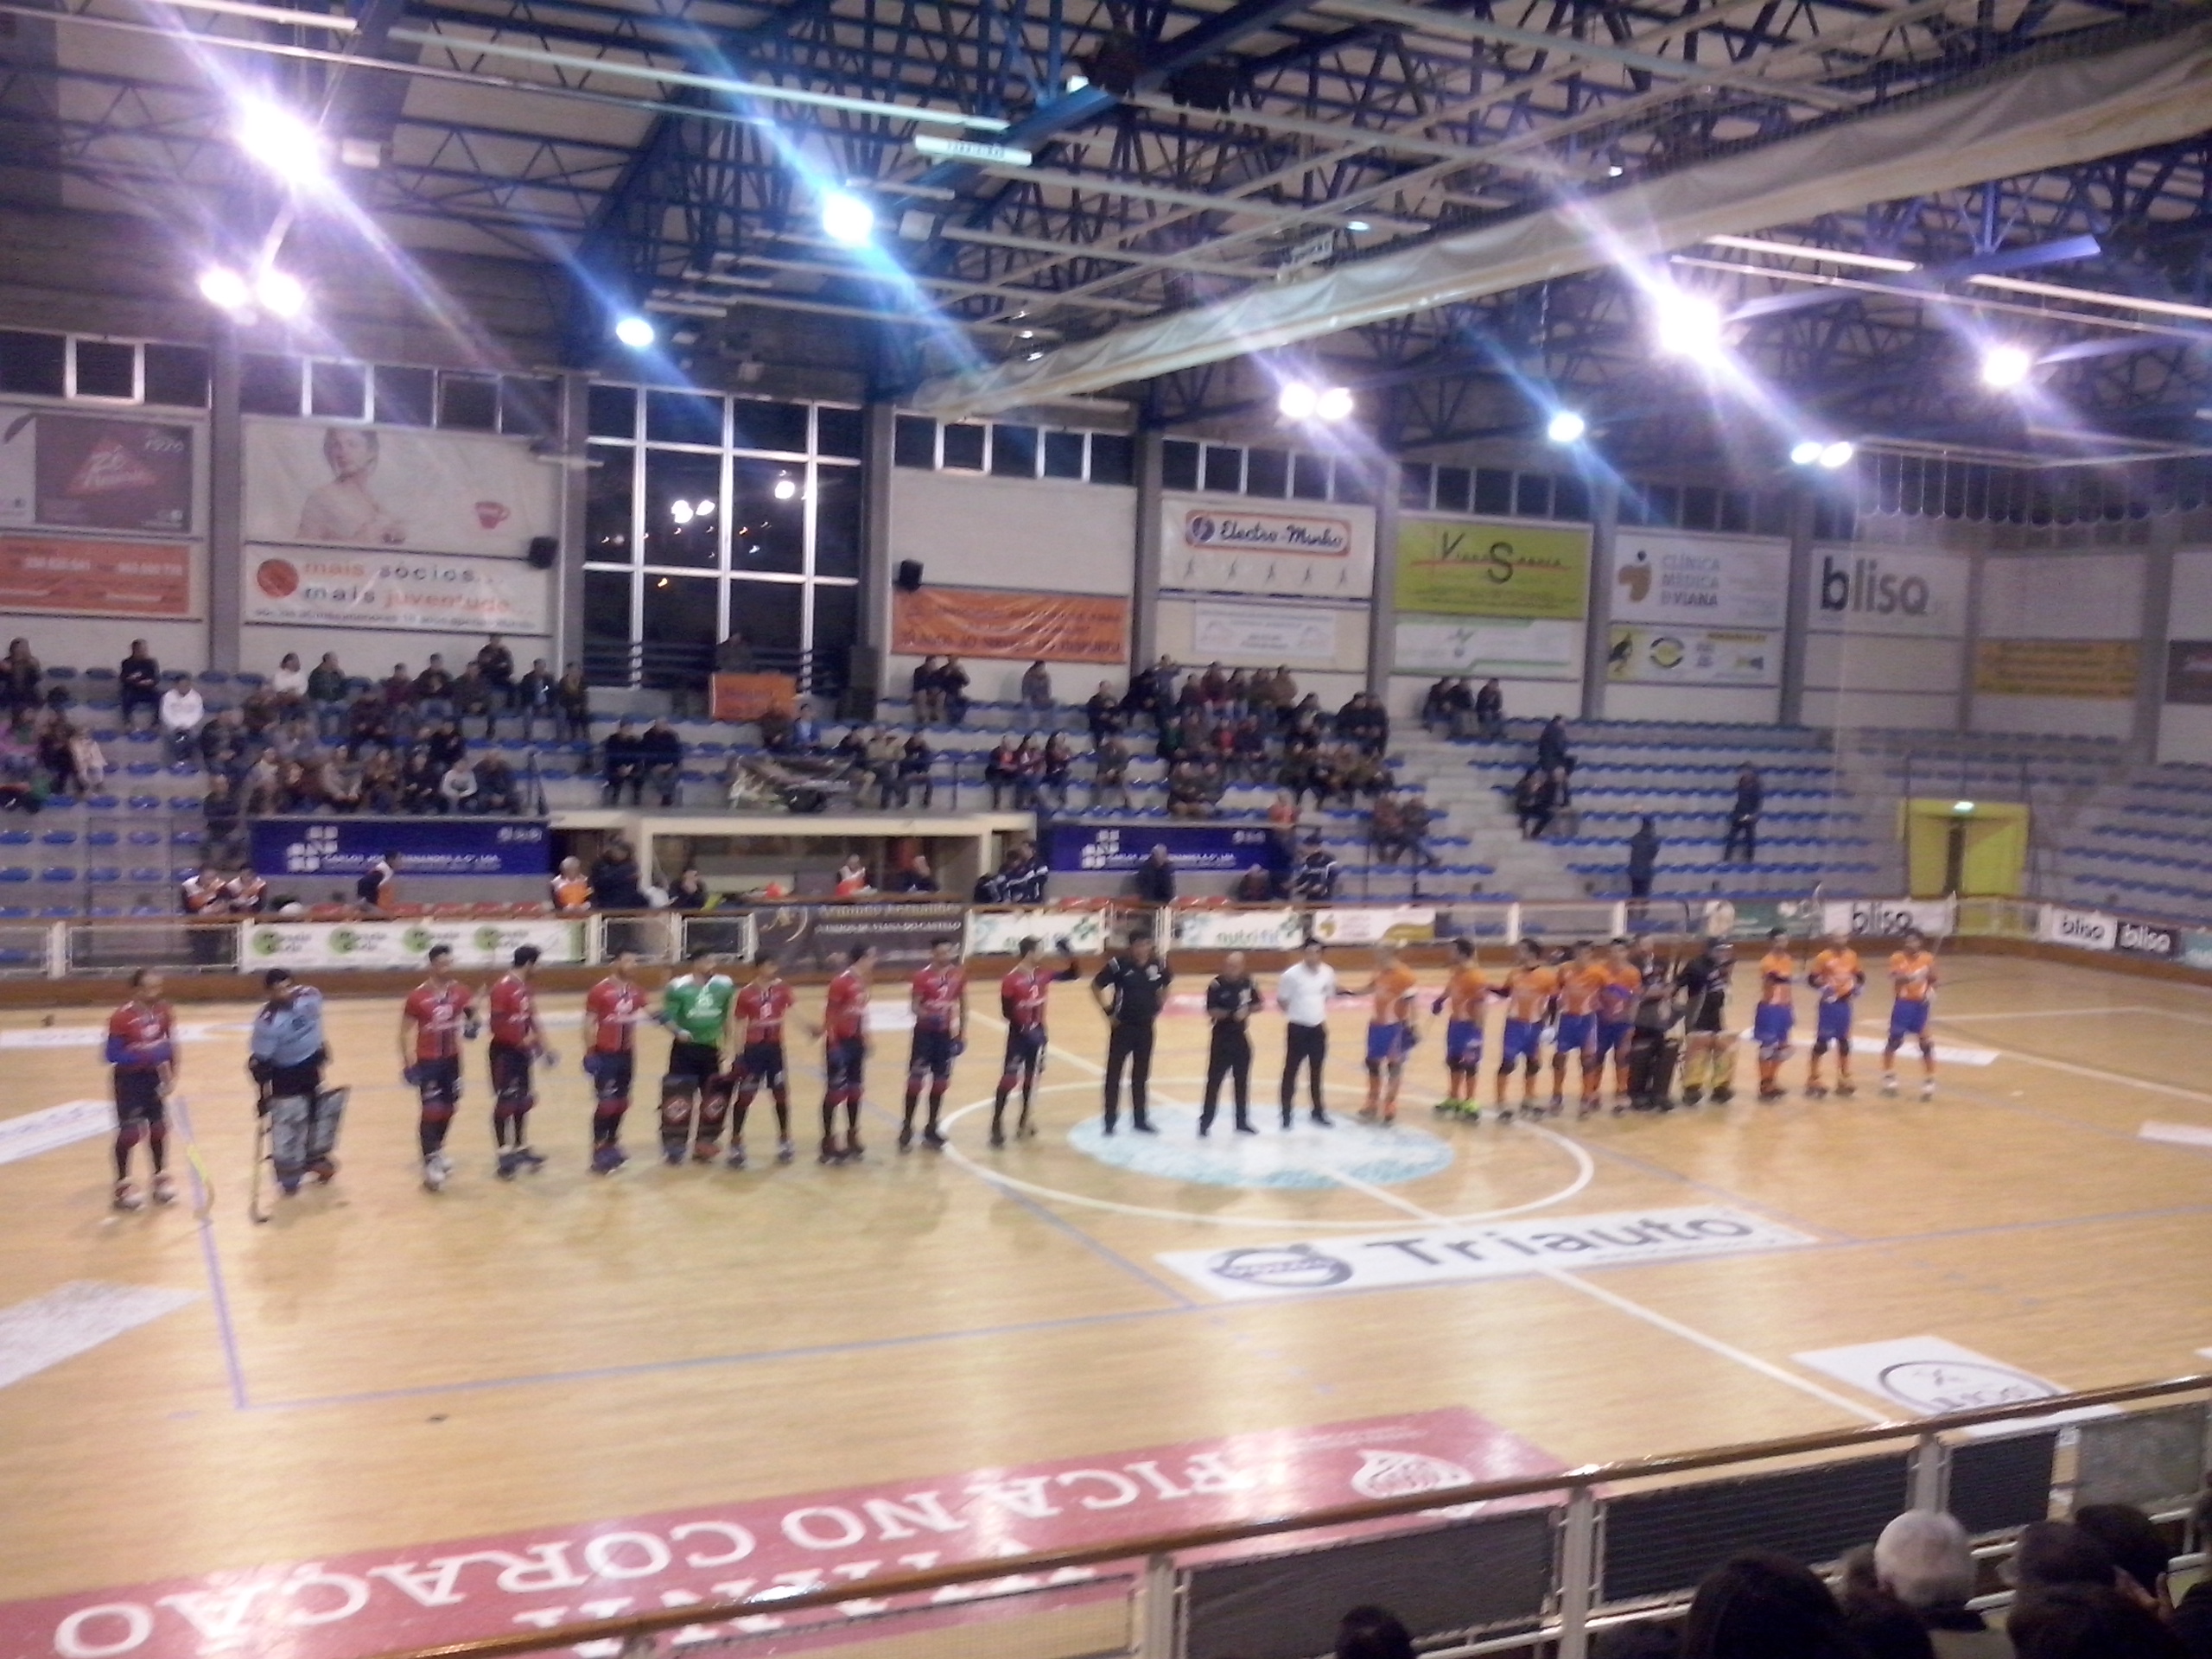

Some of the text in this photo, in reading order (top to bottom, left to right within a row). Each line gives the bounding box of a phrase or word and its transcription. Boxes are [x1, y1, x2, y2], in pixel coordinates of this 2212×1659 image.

[1365, 1217, 1756, 1268] Triauto
[780, 1491, 968, 1550] NO
[53, 1520, 757, 1658] CORAÇÃO
